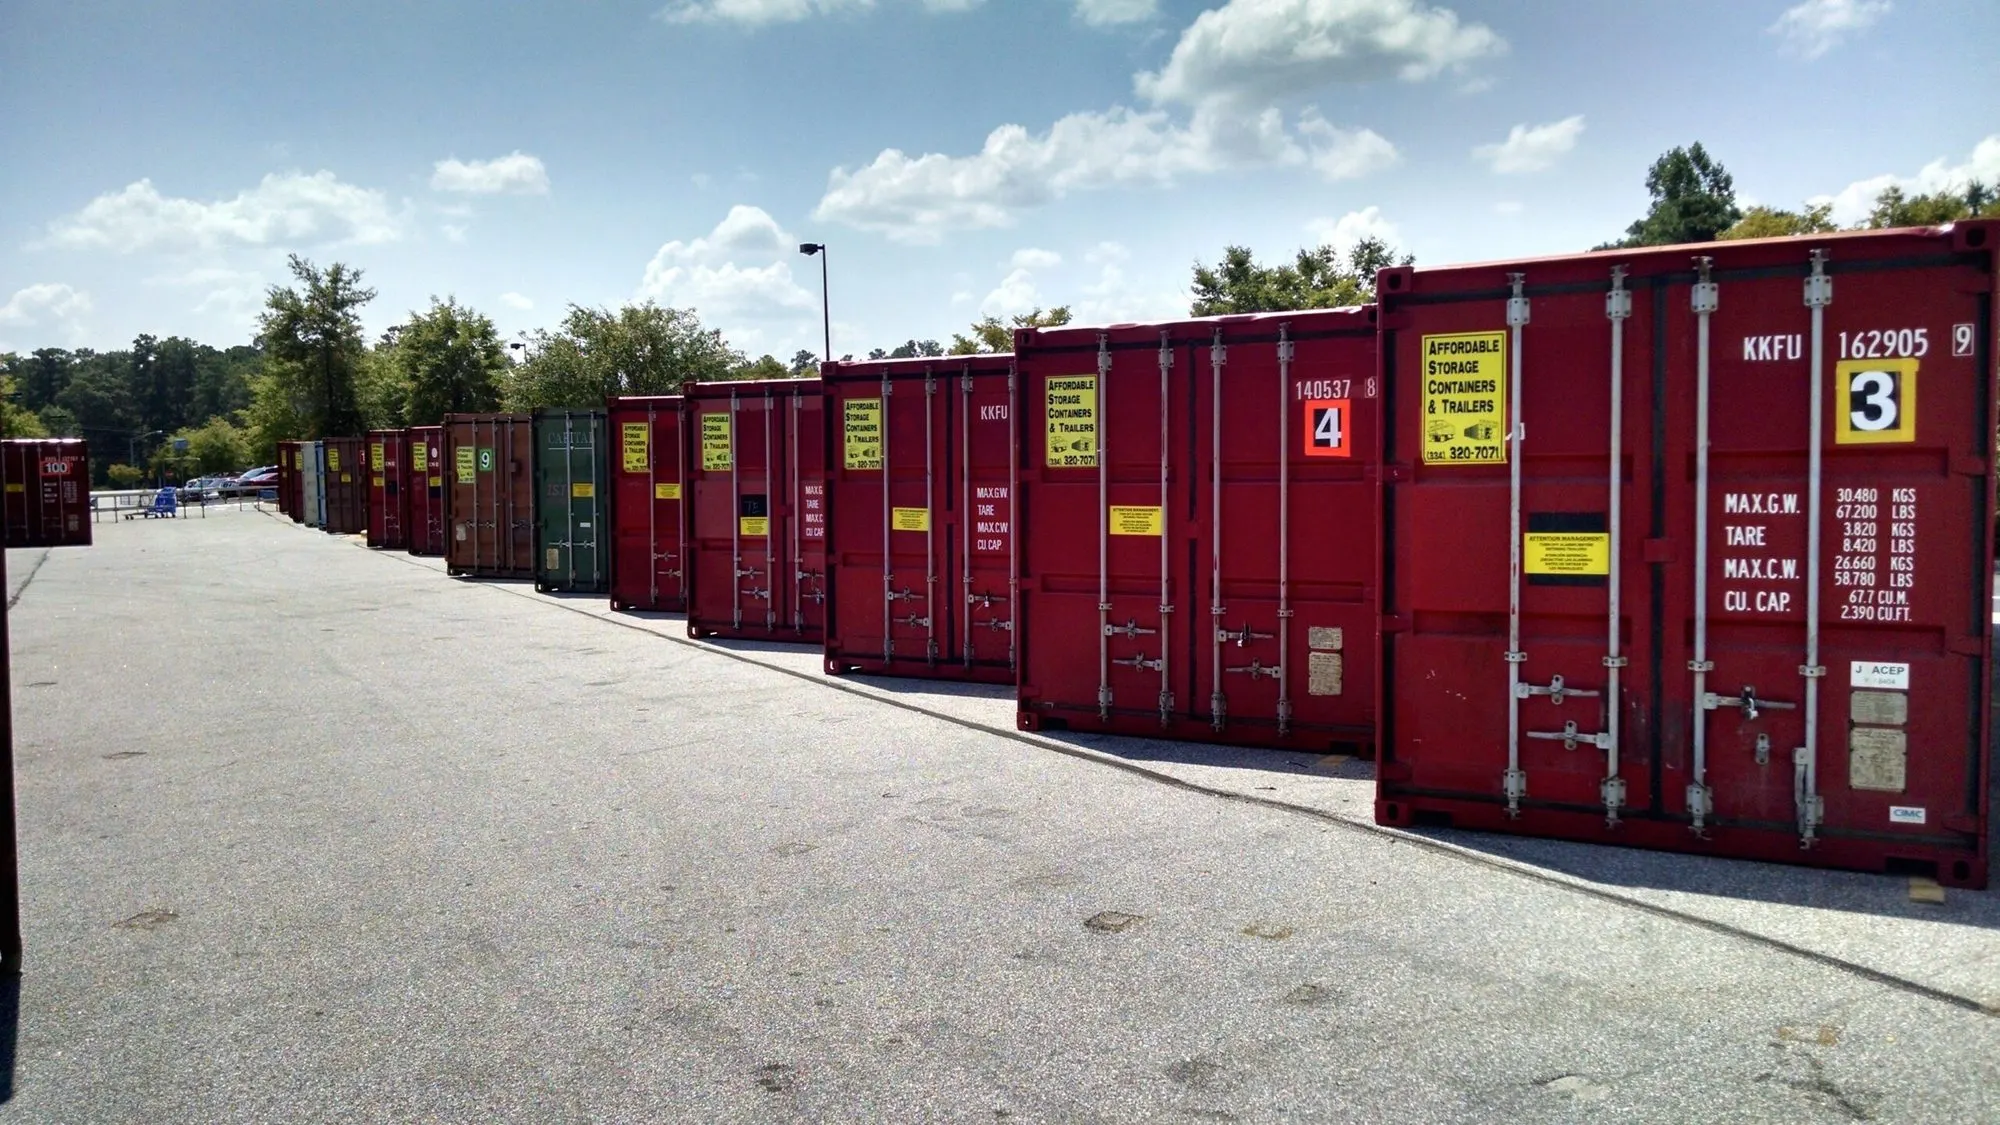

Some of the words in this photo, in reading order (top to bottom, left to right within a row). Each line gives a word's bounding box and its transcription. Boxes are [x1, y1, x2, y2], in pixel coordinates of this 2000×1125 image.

[1428, 339, 1500, 355] AFFORDABLE
[1743, 334, 1801, 360] KKFU
[1838, 328, 1928, 358] 162905
[1955, 326, 1972, 353] 9
[1428, 360, 1479, 375] STORAGE
[1048, 380, 1094, 391] AFFORDABLE
[1295, 379, 1351, 400] 140537
[1366, 378, 1376, 397] 8
[1428, 380, 1496, 394] CONTAINERS
[846, 402, 879, 410] AFFORDABLE
[1048, 394, 1081, 405] STORAGE
[1427, 399, 1436, 414] &
[1442, 399, 1494, 413] TRAILERS
[1850, 370, 1897, 431] 3
[846, 413, 869, 421] STORAGE
[980, 405, 1008, 420] KKFU
[1048, 408, 1092, 419] CONTAINERS
[1049, 423, 1055, 433] &
[1059, 423, 1094, 433] TRAILERS
[1315, 407, 1342, 448] 4
[482, 452, 490, 468] 9
[1063, 455, 1095, 465] 320-7071
[1426, 451, 1446, 460] (334)
[1449, 446, 1500, 459] 320-7071
[46, 462, 67, 473] 100
[1837, 488, 1878, 502] 30.480
[1892, 488, 1916, 503] KGS
[806, 499, 819, 509] TARE
[977, 504, 994, 516] TARE
[1725, 493, 1801, 514] MAX.G.W.
[1836, 504, 1877, 519] 67.200
[1892, 505, 1916, 519] LBS
[1725, 526, 1767, 546] TARE
[1843, 522, 1876, 537] 3.820
[1891, 522, 1915, 537] KGS
[1843, 539, 1876, 553] 8.420
[1891, 539, 1914, 553] LBS
[1725, 559, 1800, 579] MAX.C.W.
[1835, 556, 1875, 570] 26.660
[1890, 556, 1914, 571] KGS
[1834, 572, 1875, 586] 58.780
[1890, 573, 1913, 587] LBS
[1725, 591, 1752, 611] CU.
[1756, 591, 1791, 612] CAP.
[1849, 590, 1874, 604] 67.7
[1877, 590, 1909, 605] CU.M.
[1841, 606, 1874, 620] 2.390
[1877, 606, 1912, 622] CU.FT.
[1872, 666, 1905, 675] ACEP
